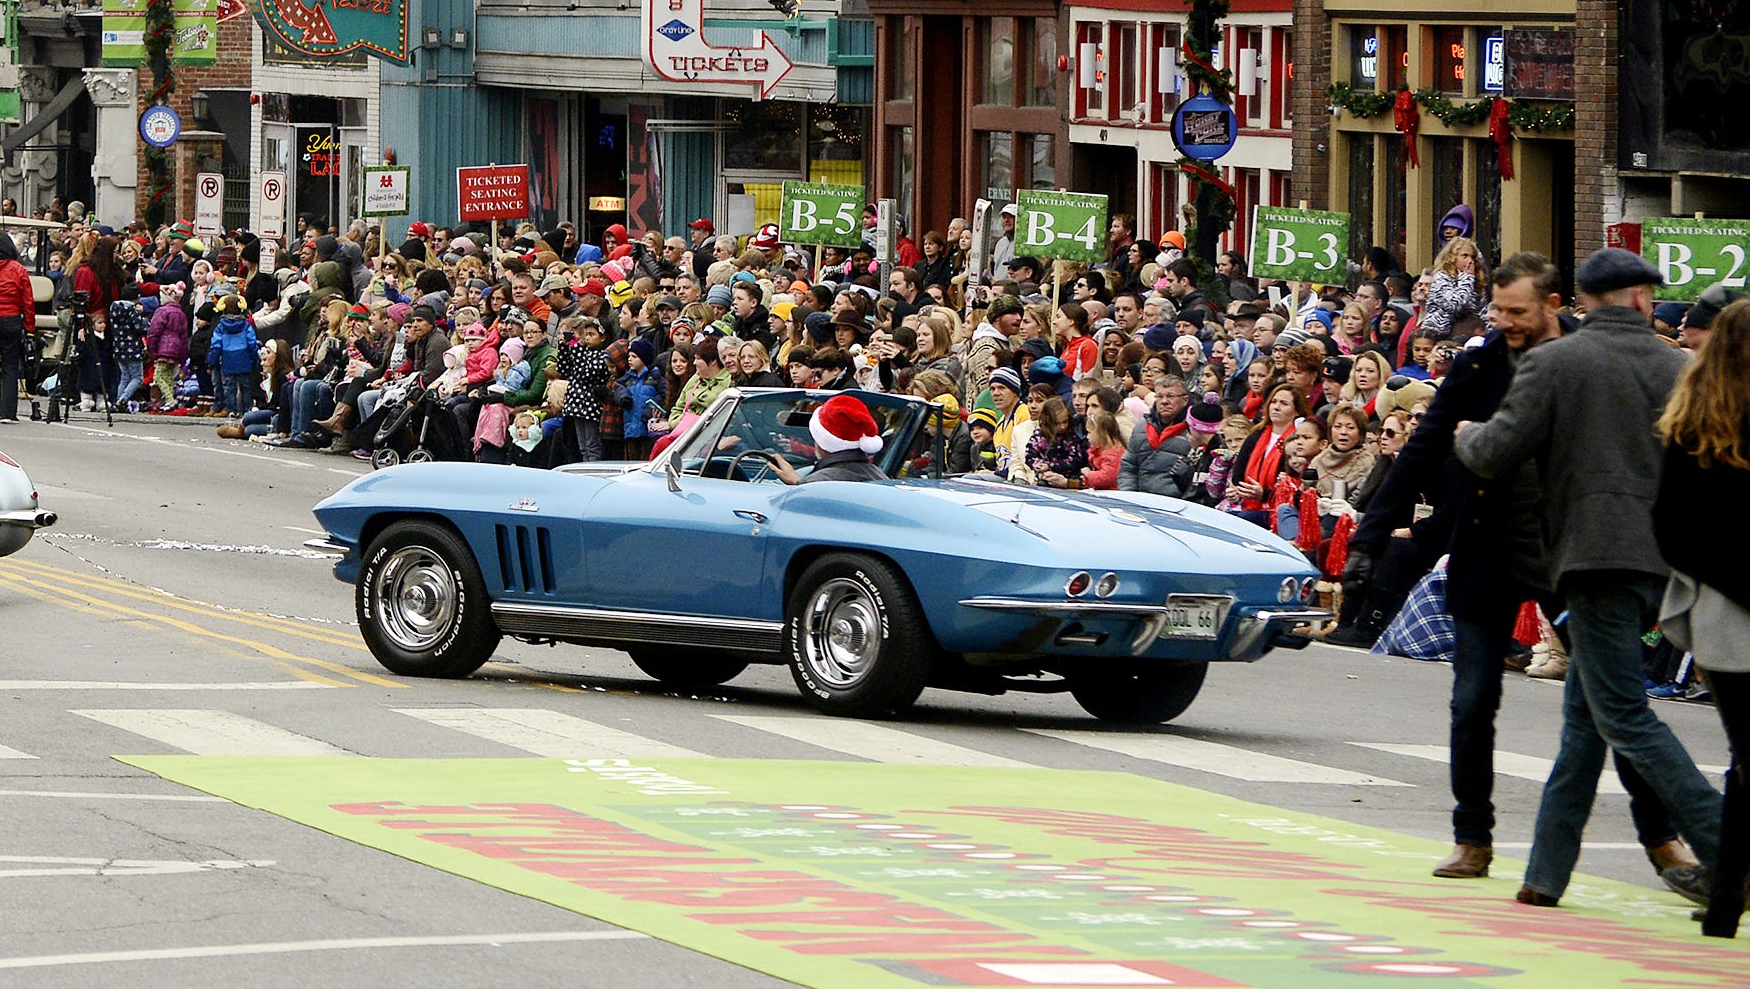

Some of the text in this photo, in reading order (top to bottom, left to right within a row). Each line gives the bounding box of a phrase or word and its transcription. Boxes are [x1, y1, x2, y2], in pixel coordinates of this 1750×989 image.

[668, 56, 769, 72] TICKETS
[466, 174, 521, 188] TICKETED
[470, 188, 517, 199] SEATING
[791, 187, 858, 198] TICKETED SEATING
[988, 187, 1012, 201] ERNES
[465, 200, 523, 212] ENTRANCE
[596, 199, 620, 208] ATM
[1026, 196, 1102, 210] TICKETED SEATING
[789, 199, 857, 235] B-5
[1265, 213, 1343, 226] TICKETED SEATING
[1024, 211, 1098, 251] B-4
[1652, 226, 1747, 236] TICKETED SEATING
[1264, 228, 1339, 270] B-3
[1655, 242, 1747, 287] B-2
[372, 547, 388, 565] T/A
[363, 568, 375, 619] Radial
[855, 570, 890, 639] Radial T/A
[434, 570, 466, 657] BFGoodrich
[1198, 611, 1211, 627] 66
[791, 616, 831, 700] BFGoodrich
